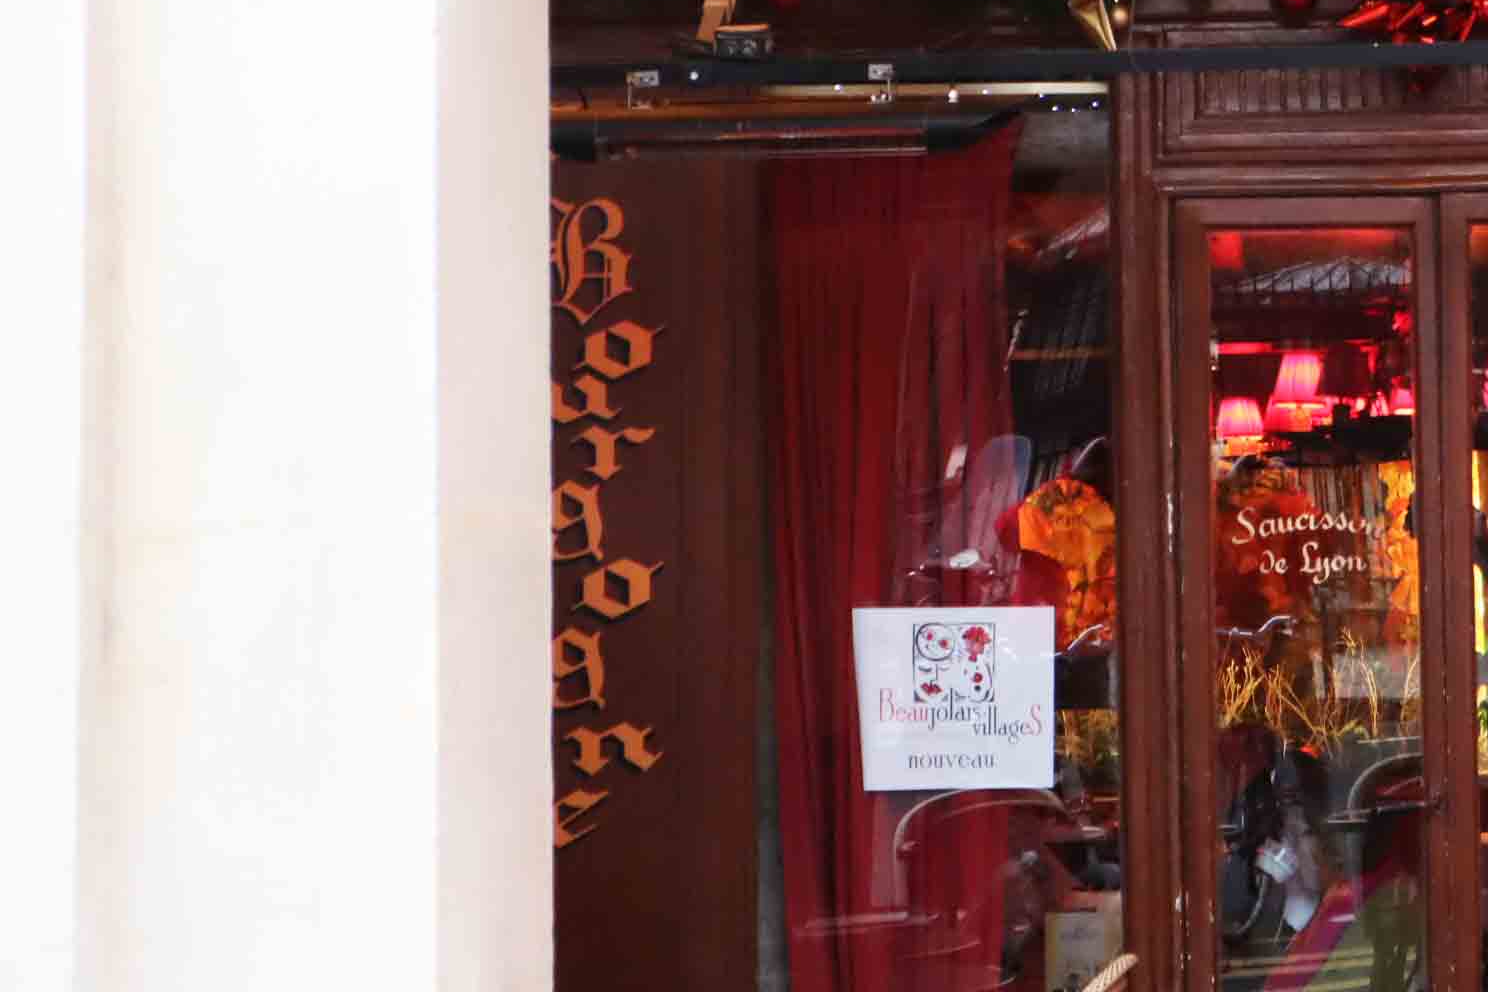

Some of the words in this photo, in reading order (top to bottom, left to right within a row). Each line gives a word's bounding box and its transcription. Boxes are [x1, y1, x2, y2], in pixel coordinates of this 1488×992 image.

[1232, 507, 1384, 545] Saucisson
[1259, 550, 1288, 574] de
[1299, 541, 1367, 584] Lyon
[879, 688, 981, 730] Beaujolais
[908, 752, 997, 769] nouveau
